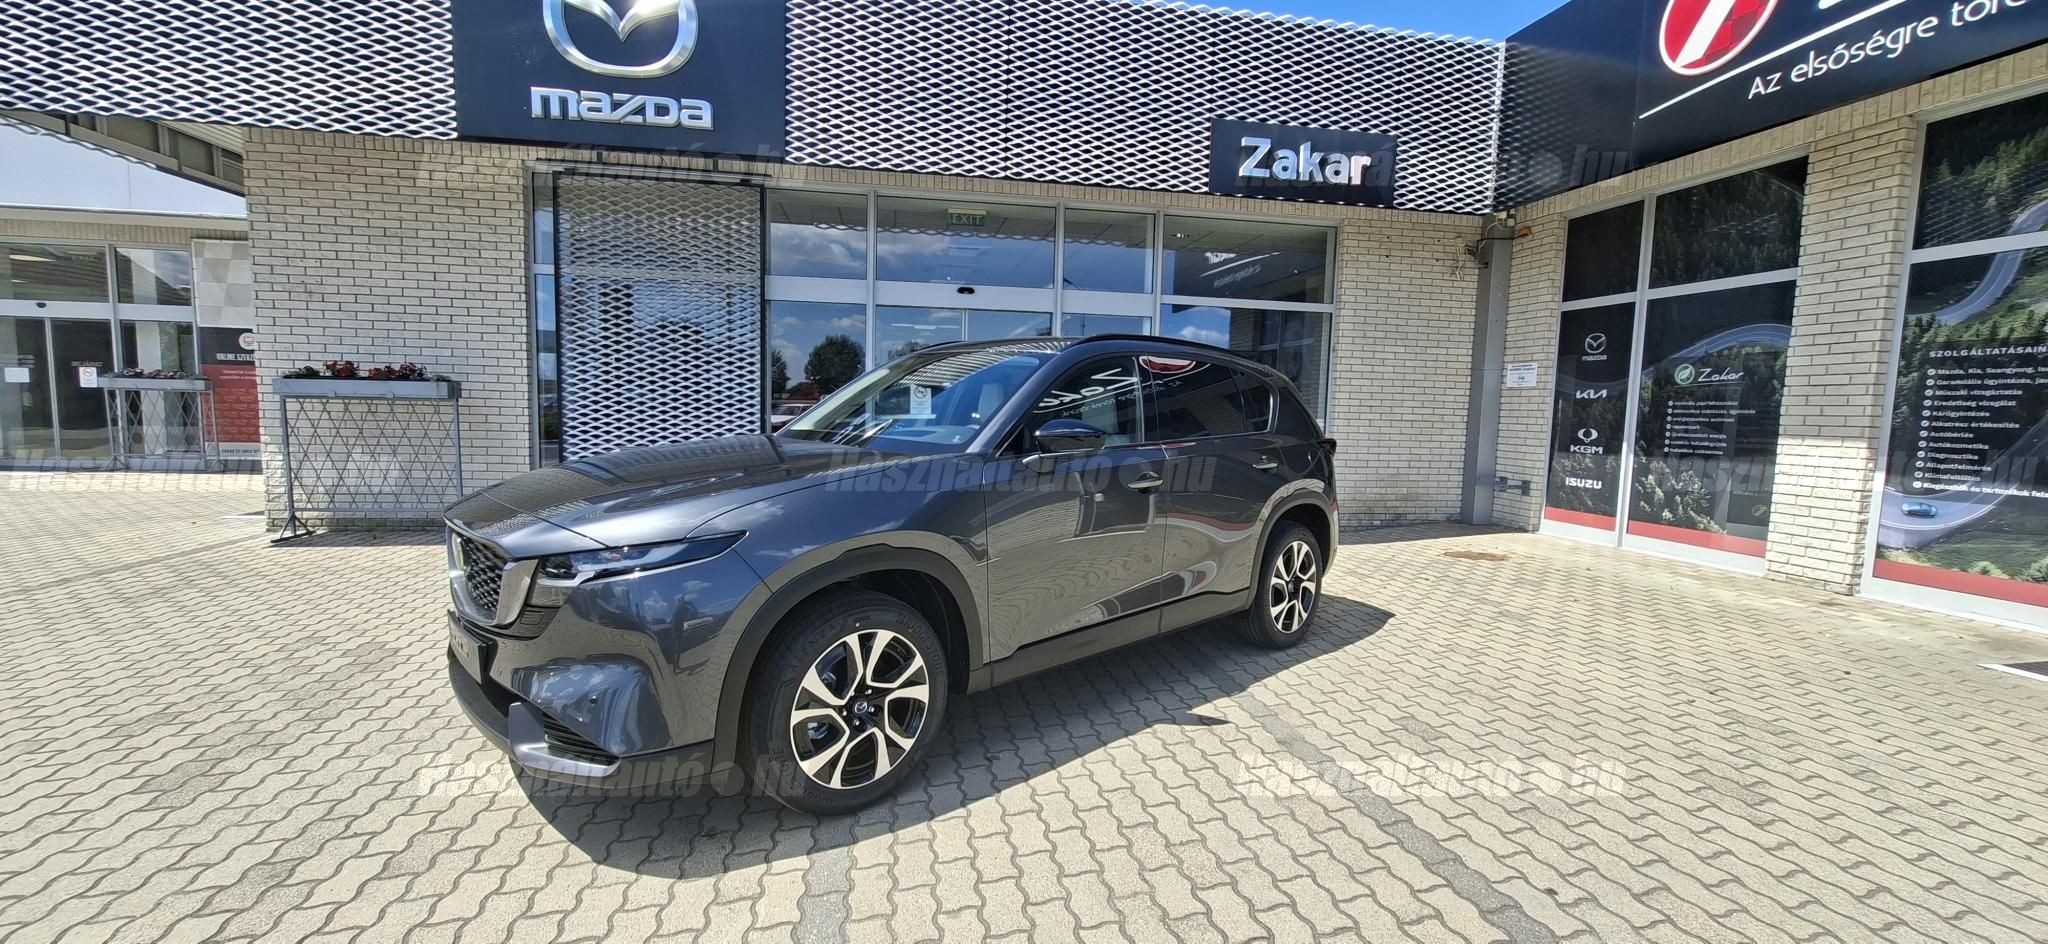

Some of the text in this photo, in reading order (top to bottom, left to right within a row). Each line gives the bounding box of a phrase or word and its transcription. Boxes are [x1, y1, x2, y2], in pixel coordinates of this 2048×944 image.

[1748, 71, 1783, 99] Az
[1791, 16, 1939, 83] elsőségre
[1239, 136, 1372, 186] Zakar
[952, 213, 983, 225] EXIT
[1698, 367, 1744, 381] Zakar
[1570, 445, 1603, 454] KGM
[1566, 477, 1602, 489] ISUZU
